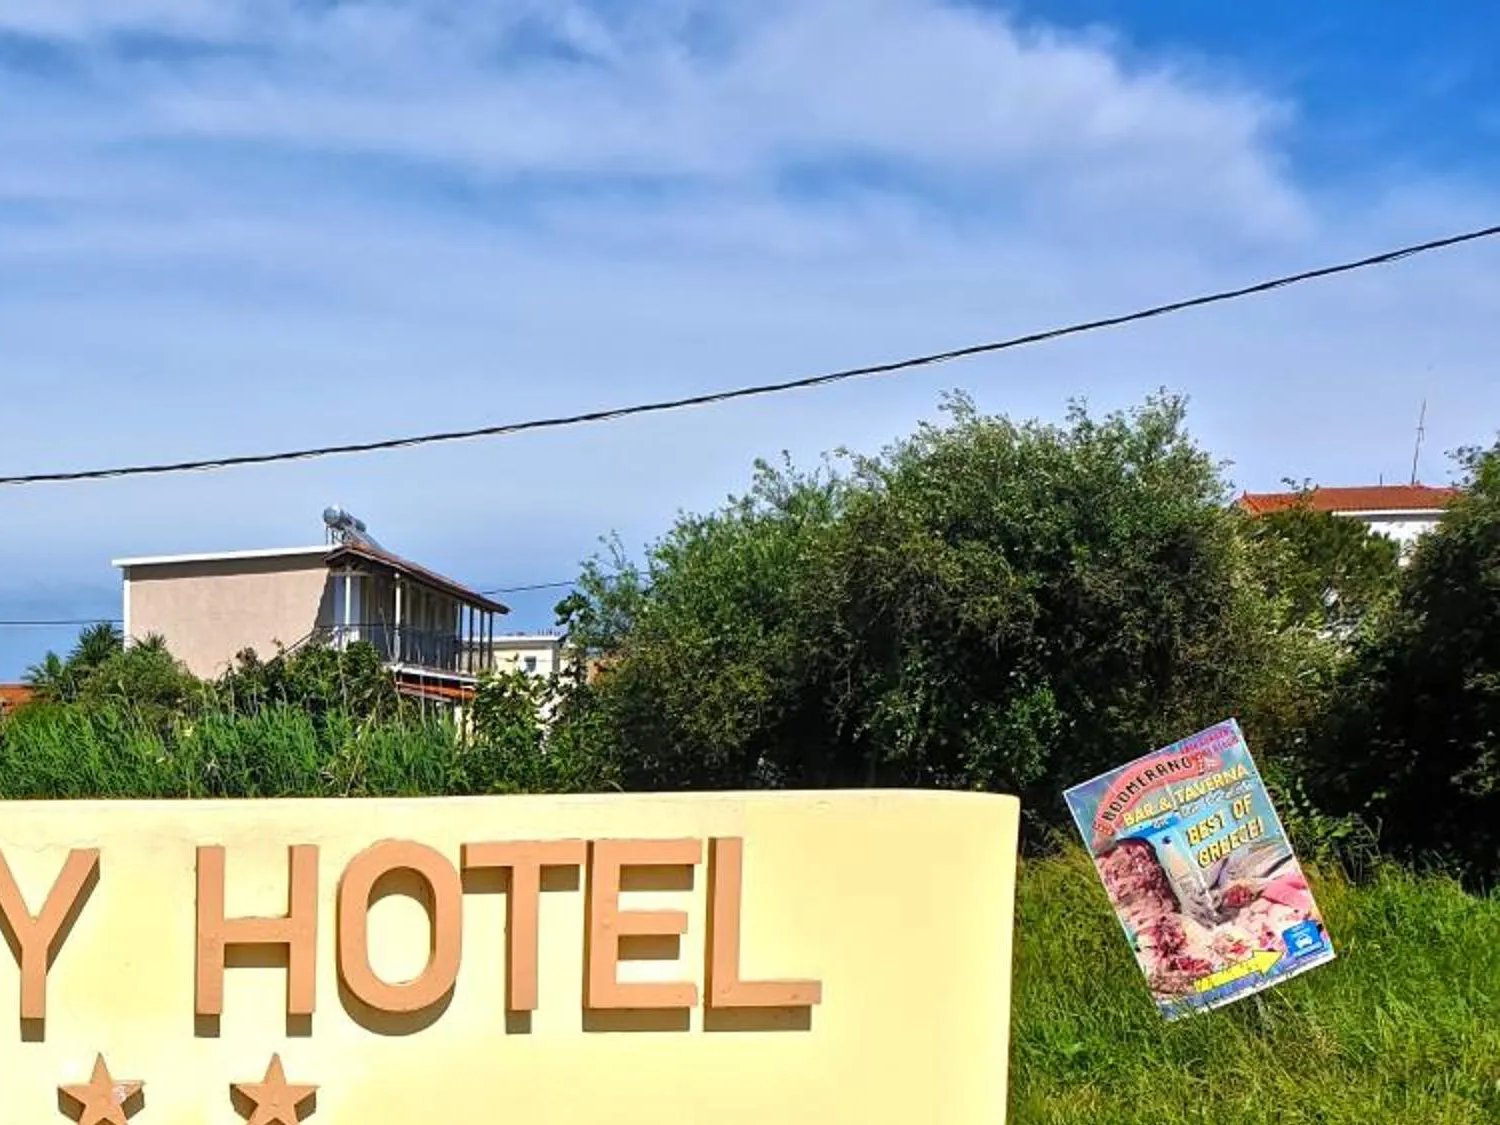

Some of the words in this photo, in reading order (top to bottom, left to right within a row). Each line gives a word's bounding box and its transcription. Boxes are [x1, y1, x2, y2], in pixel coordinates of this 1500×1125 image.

[1122, 803, 1153, 826] BAR
[1173, 763, 1249, 803] TAVERNA
[1186, 810, 1226, 848] BEST
[1231, 793, 1253, 821] OF
[194, 836, 821, 1037] HOTEL
